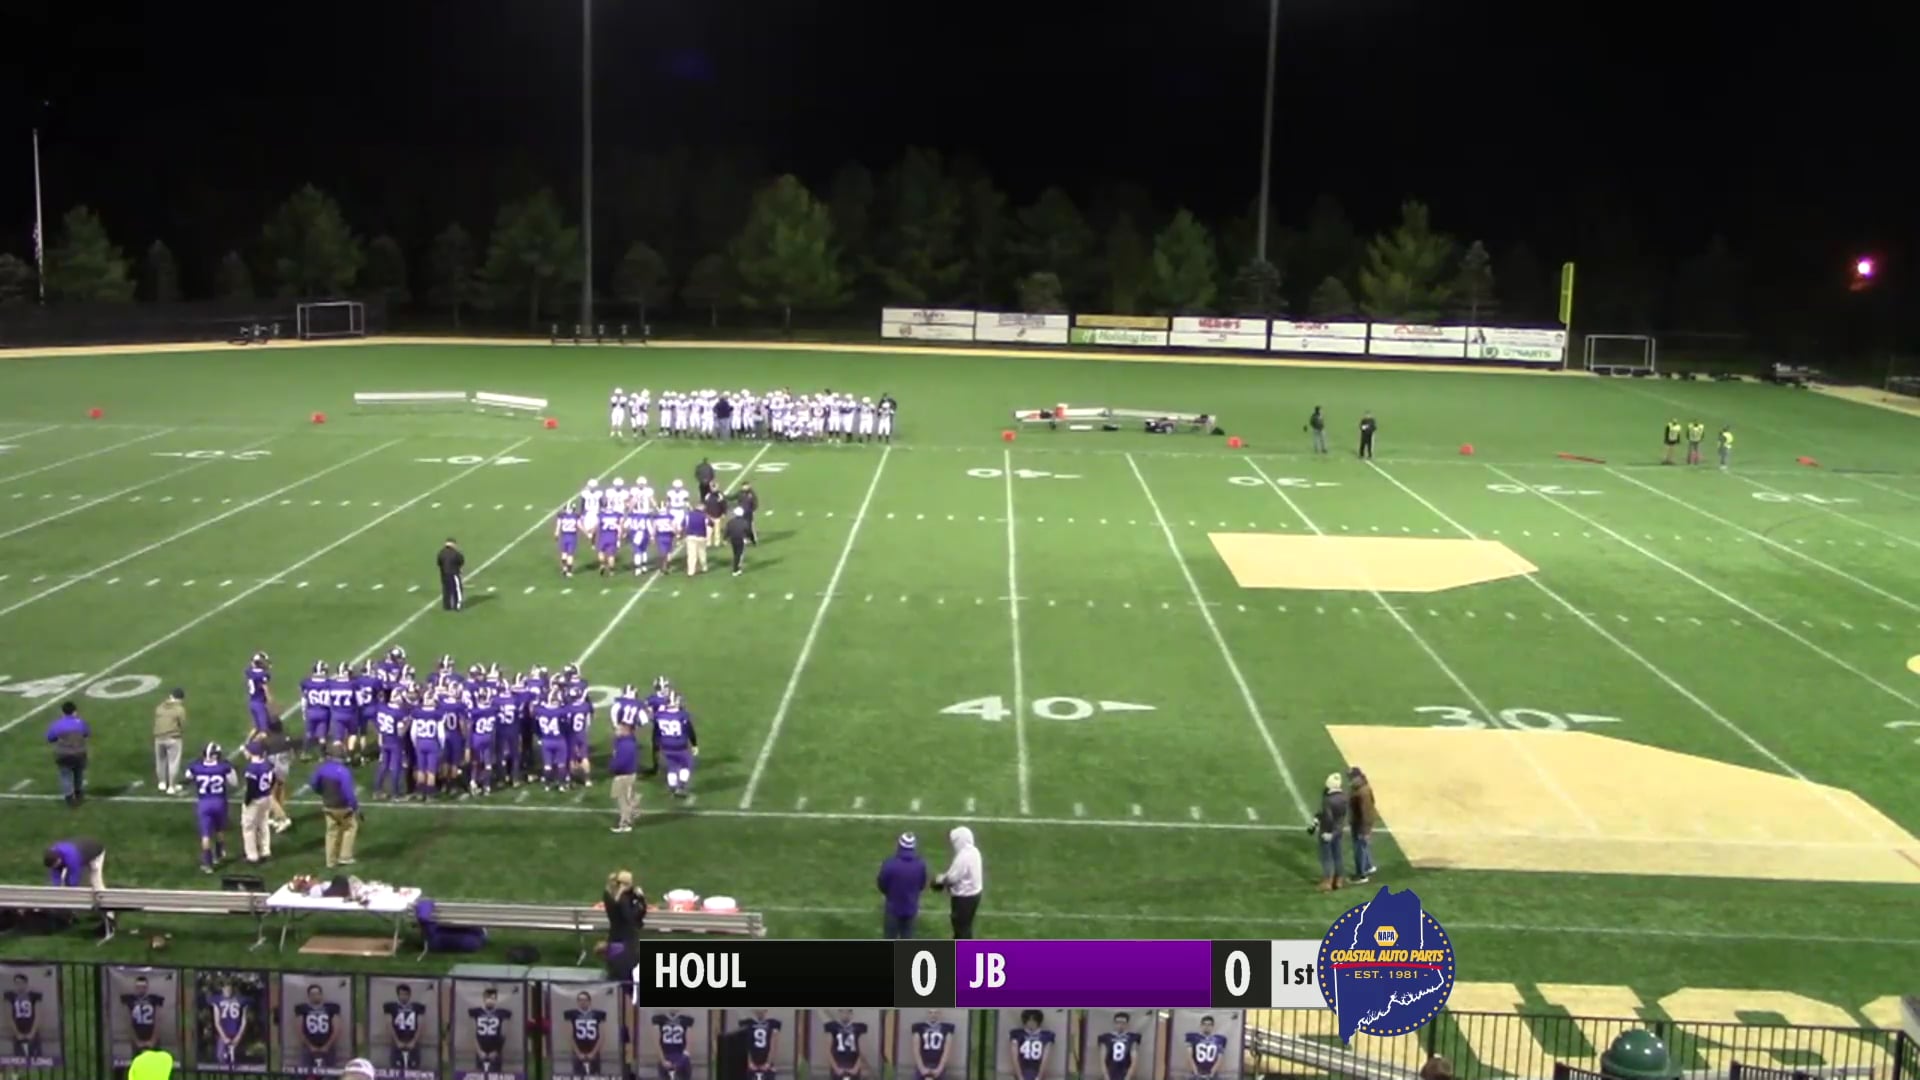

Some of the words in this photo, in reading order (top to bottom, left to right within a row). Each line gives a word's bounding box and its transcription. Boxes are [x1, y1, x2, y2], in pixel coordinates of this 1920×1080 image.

[0, 672, 162, 699] 40
[938, 695, 1094, 722] 40
[1414, 706, 1569, 731] 30
[196, 775, 224, 794] 72
[132, 1004, 153, 1024] 42
[219, 1001, 239, 1018] 76
[306, 1014, 330, 1033] 66
[394, 1012, 416, 1030] 44
[477, 1018, 500, 1035] 52
[575, 1019, 597, 1039] 55
[662, 1026, 684, 1044] 22
[836, 1034, 855, 1051] 14
[1020, 1041, 1043, 1060] 48
[1113, 1042, 1126, 1061] 8
[1195, 1044, 1218, 1062] 60
